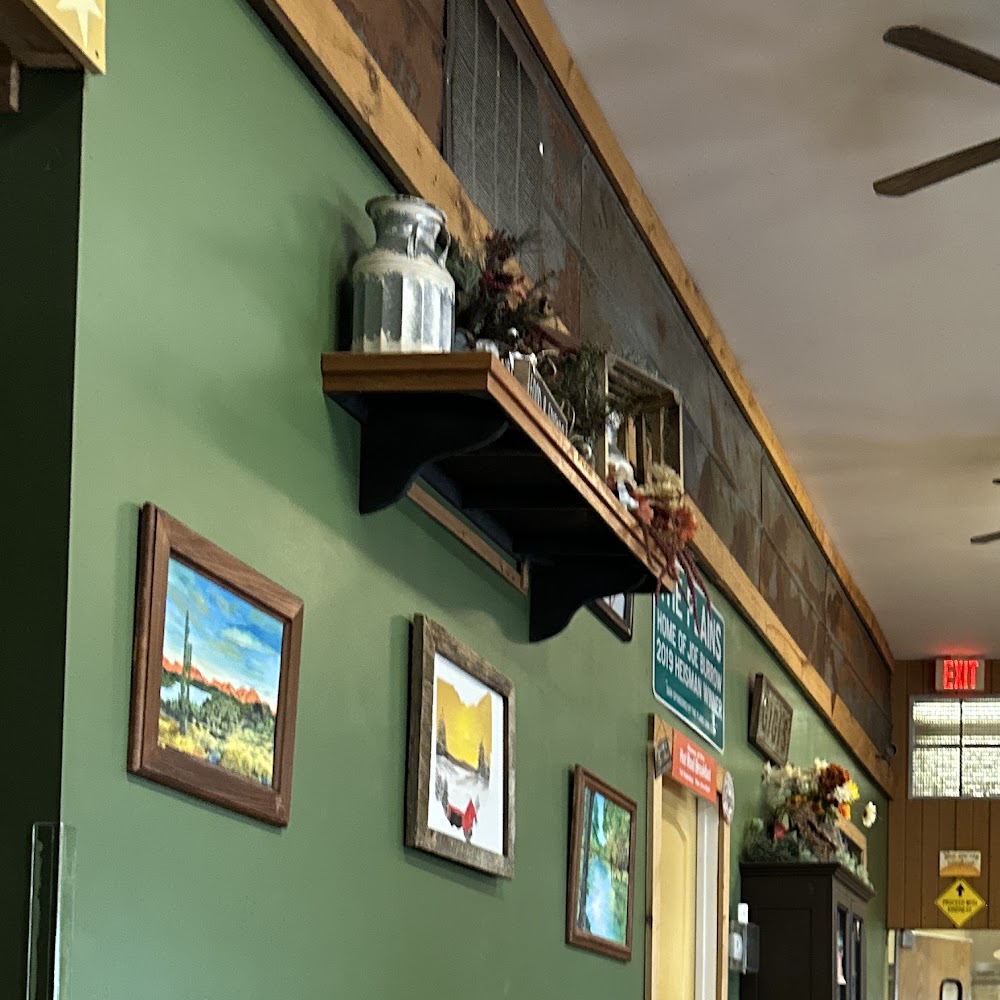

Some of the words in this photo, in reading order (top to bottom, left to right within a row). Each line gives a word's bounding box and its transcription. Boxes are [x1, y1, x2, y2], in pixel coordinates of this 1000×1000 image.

[656, 609, 676, 648] HOME
[677, 632, 687, 655] OF
[687, 641, 699, 671] JOE
[700, 652, 722, 694] BURROW
[656, 637, 674, 673] 2019
[674, 655, 702, 698] HEISMAN
[702, 681, 723, 722] WINNER
[943, 659, 979, 690] EXIT
